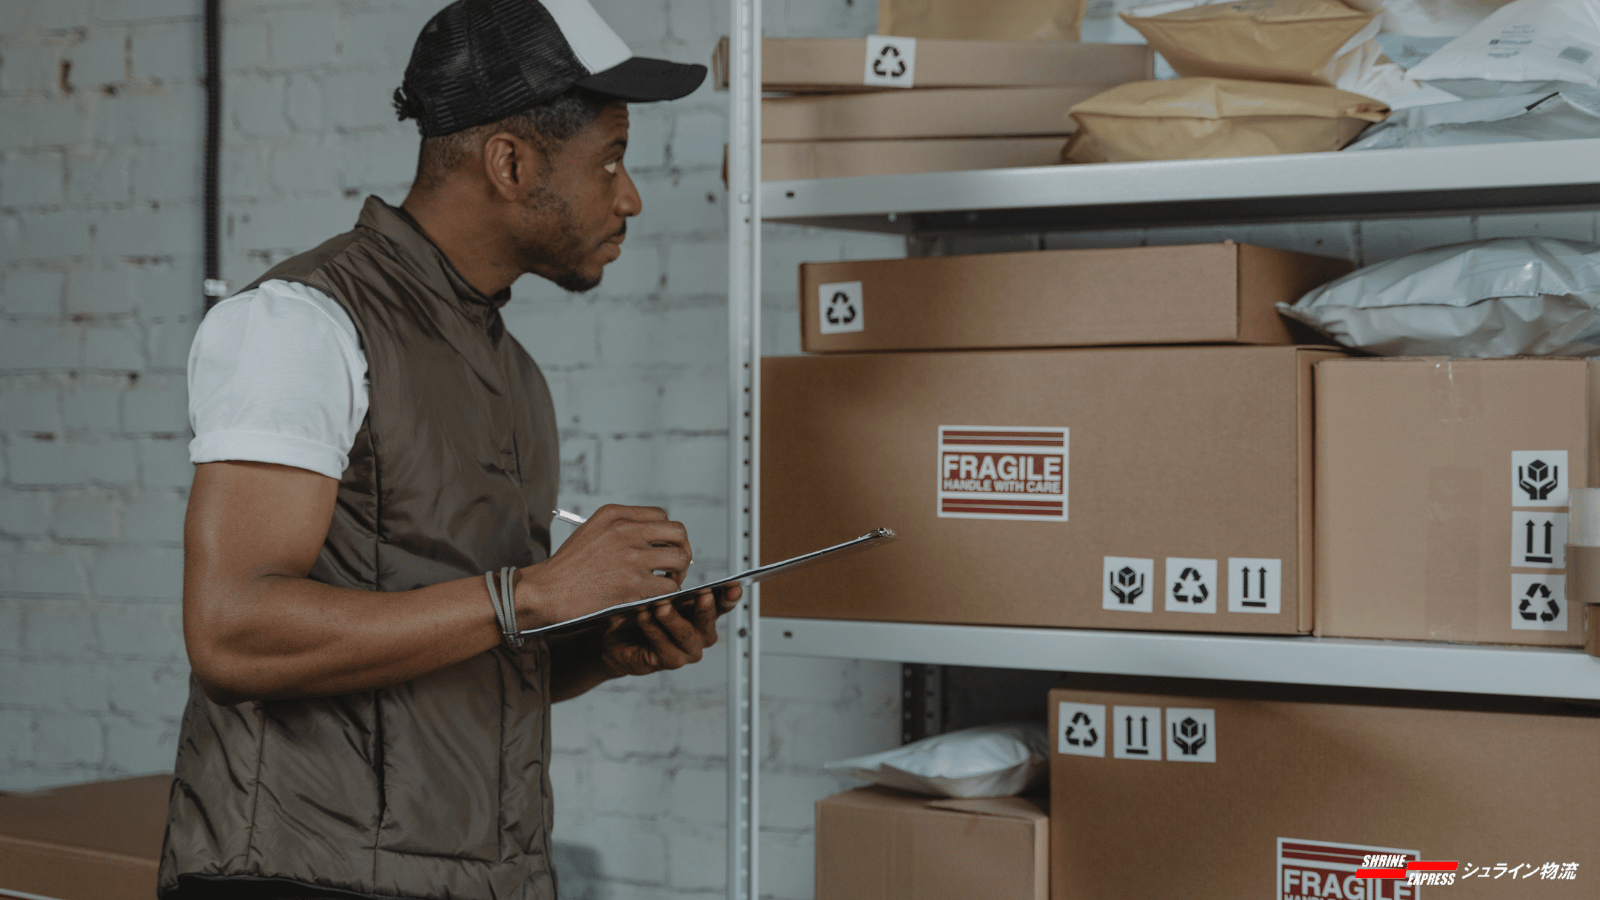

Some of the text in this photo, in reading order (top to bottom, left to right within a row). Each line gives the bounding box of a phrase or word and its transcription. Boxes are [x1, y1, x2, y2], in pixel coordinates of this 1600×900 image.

[943, 455, 1061, 480] FRAGILE
[943, 480, 1061, 493] HANDLE WITH CARE
[1283, 868, 1412, 900] FRAGILE
